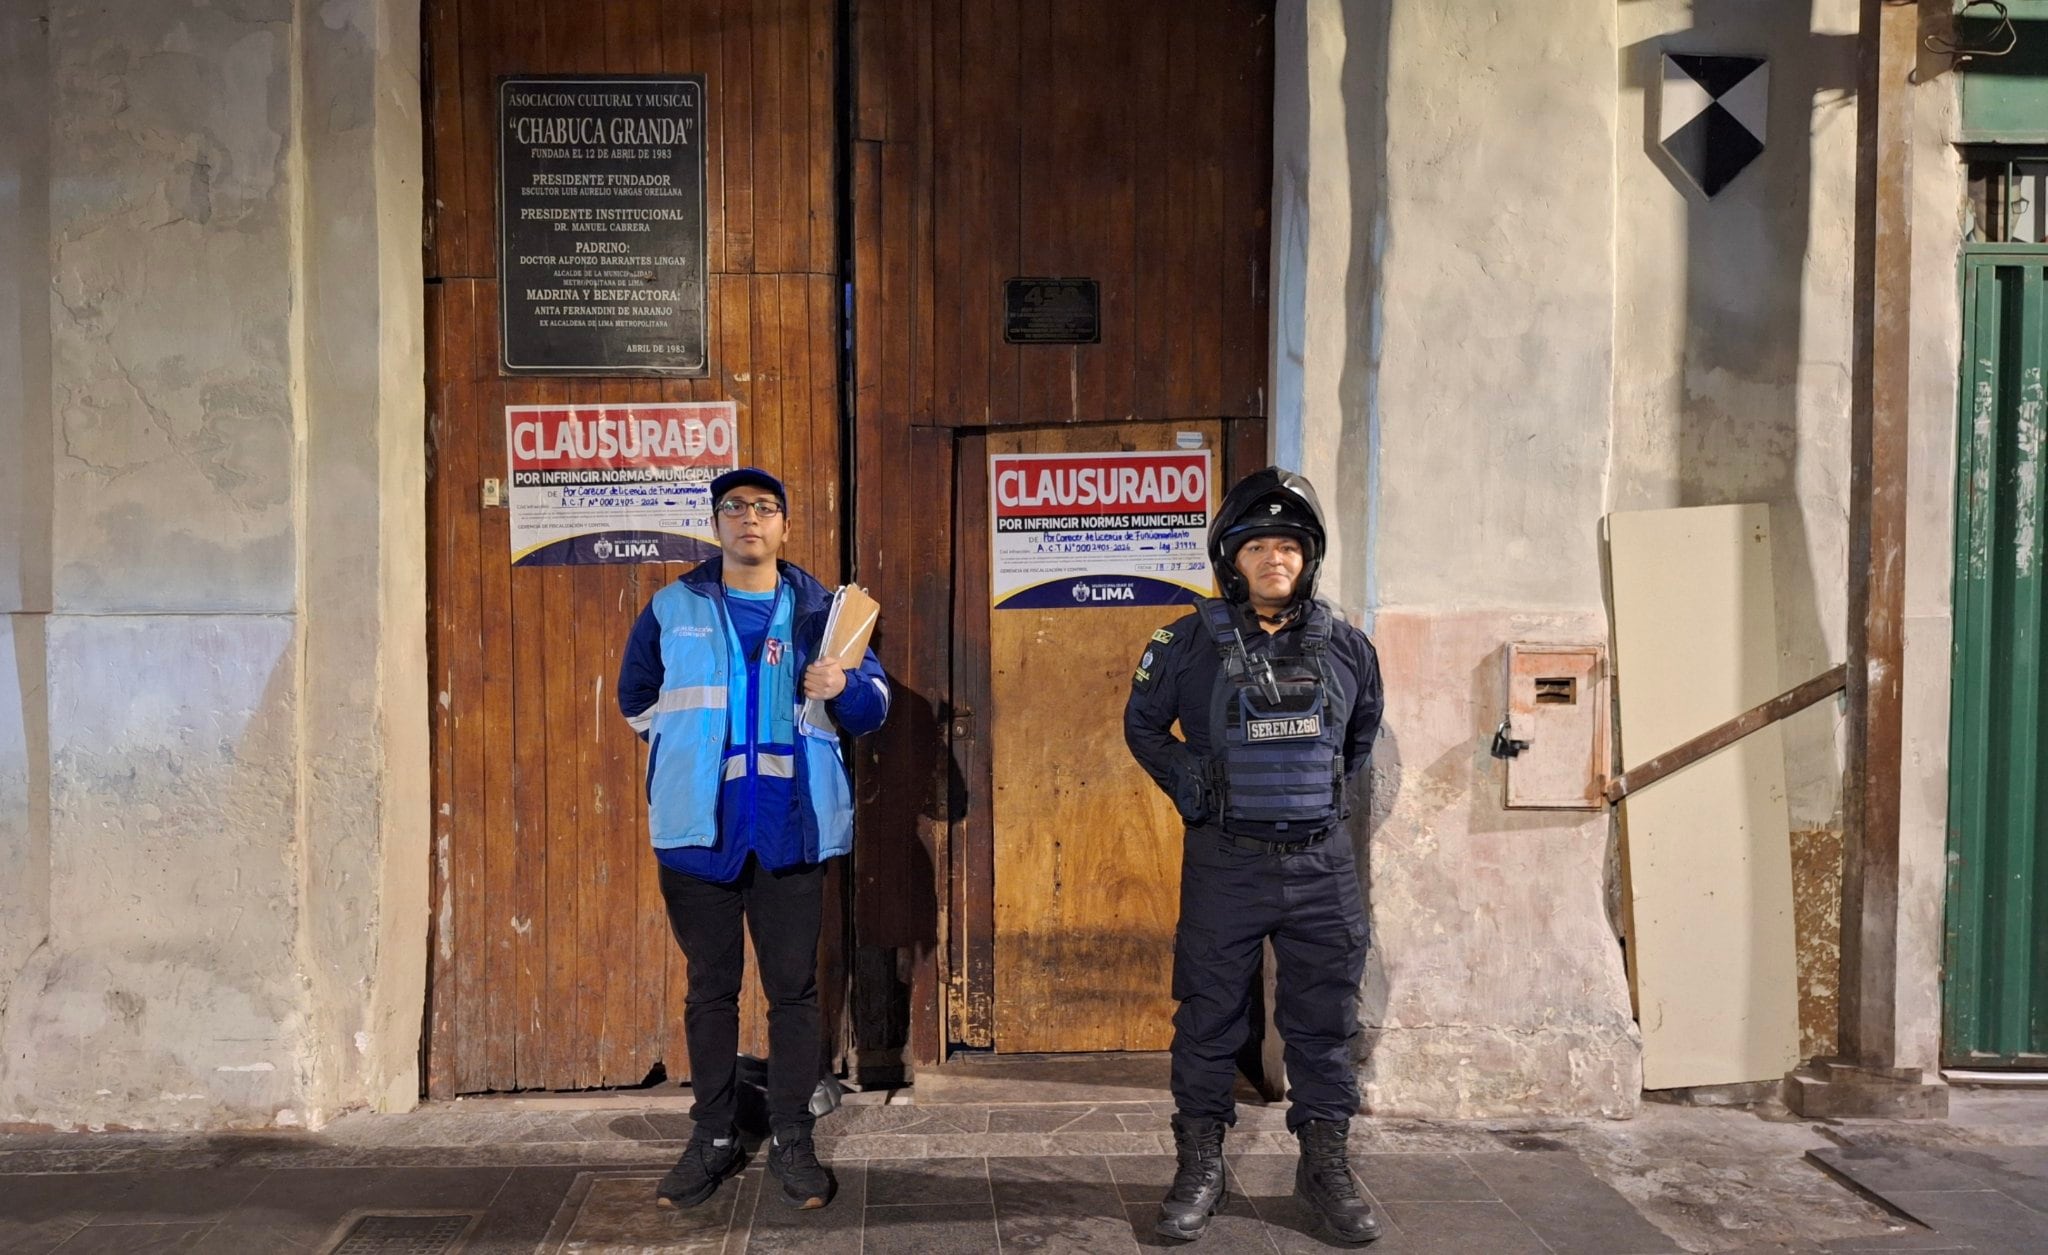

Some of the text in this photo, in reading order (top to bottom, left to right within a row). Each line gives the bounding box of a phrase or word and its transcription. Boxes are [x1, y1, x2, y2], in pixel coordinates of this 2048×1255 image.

[508, 94, 694, 107] ASOCIACION CULTURAL Y MUSICAL
[531, 148, 672, 159] FUNDADA EL 12 DE ABRIL DE 1983
[532, 174, 671, 186] PRESIDENTE FUNDADOR
[521, 187, 683, 196] ESCULTOR LUIS AURELIO VARGAS ORELLANA
[521, 208, 683, 220] PRESIDENTE INSTITUCIONAL
[554, 223, 651, 232] DR. MANUEL CABRERA
[575, 242, 631, 254] PADRINO:
[520, 256, 686, 266] DOCTOR ALFONZO BARRANTES LINGAN
[526, 289, 681, 301] MADRINA Y BENEFACTORA:
[534, 306, 673, 316] ANITA FERNANDINI DE NARANJO
[539, 319, 549, 327] EX
[615, 320, 668, 328] METROPOLITANA
[626, 345, 651, 353] ABRIL
[653, 345, 665, 353] DE
[513, 418, 731, 460] CLAUSURADO
[515, 472, 540, 485] POR
[542, 470, 600, 484] INFRINGIR
[602, 469, 652, 482] NORMAS
[997, 465, 1205, 507] CLAUSURADO
[547, 490, 558, 498] DE
[999, 514, 1205, 530] POR INFRINGIR NORMAS MUNICIPALES
[614, 544, 660, 558] LIMA
[1091, 587, 1135, 601] LIMA
[1251, 718, 1317, 738] SERENAZGO
